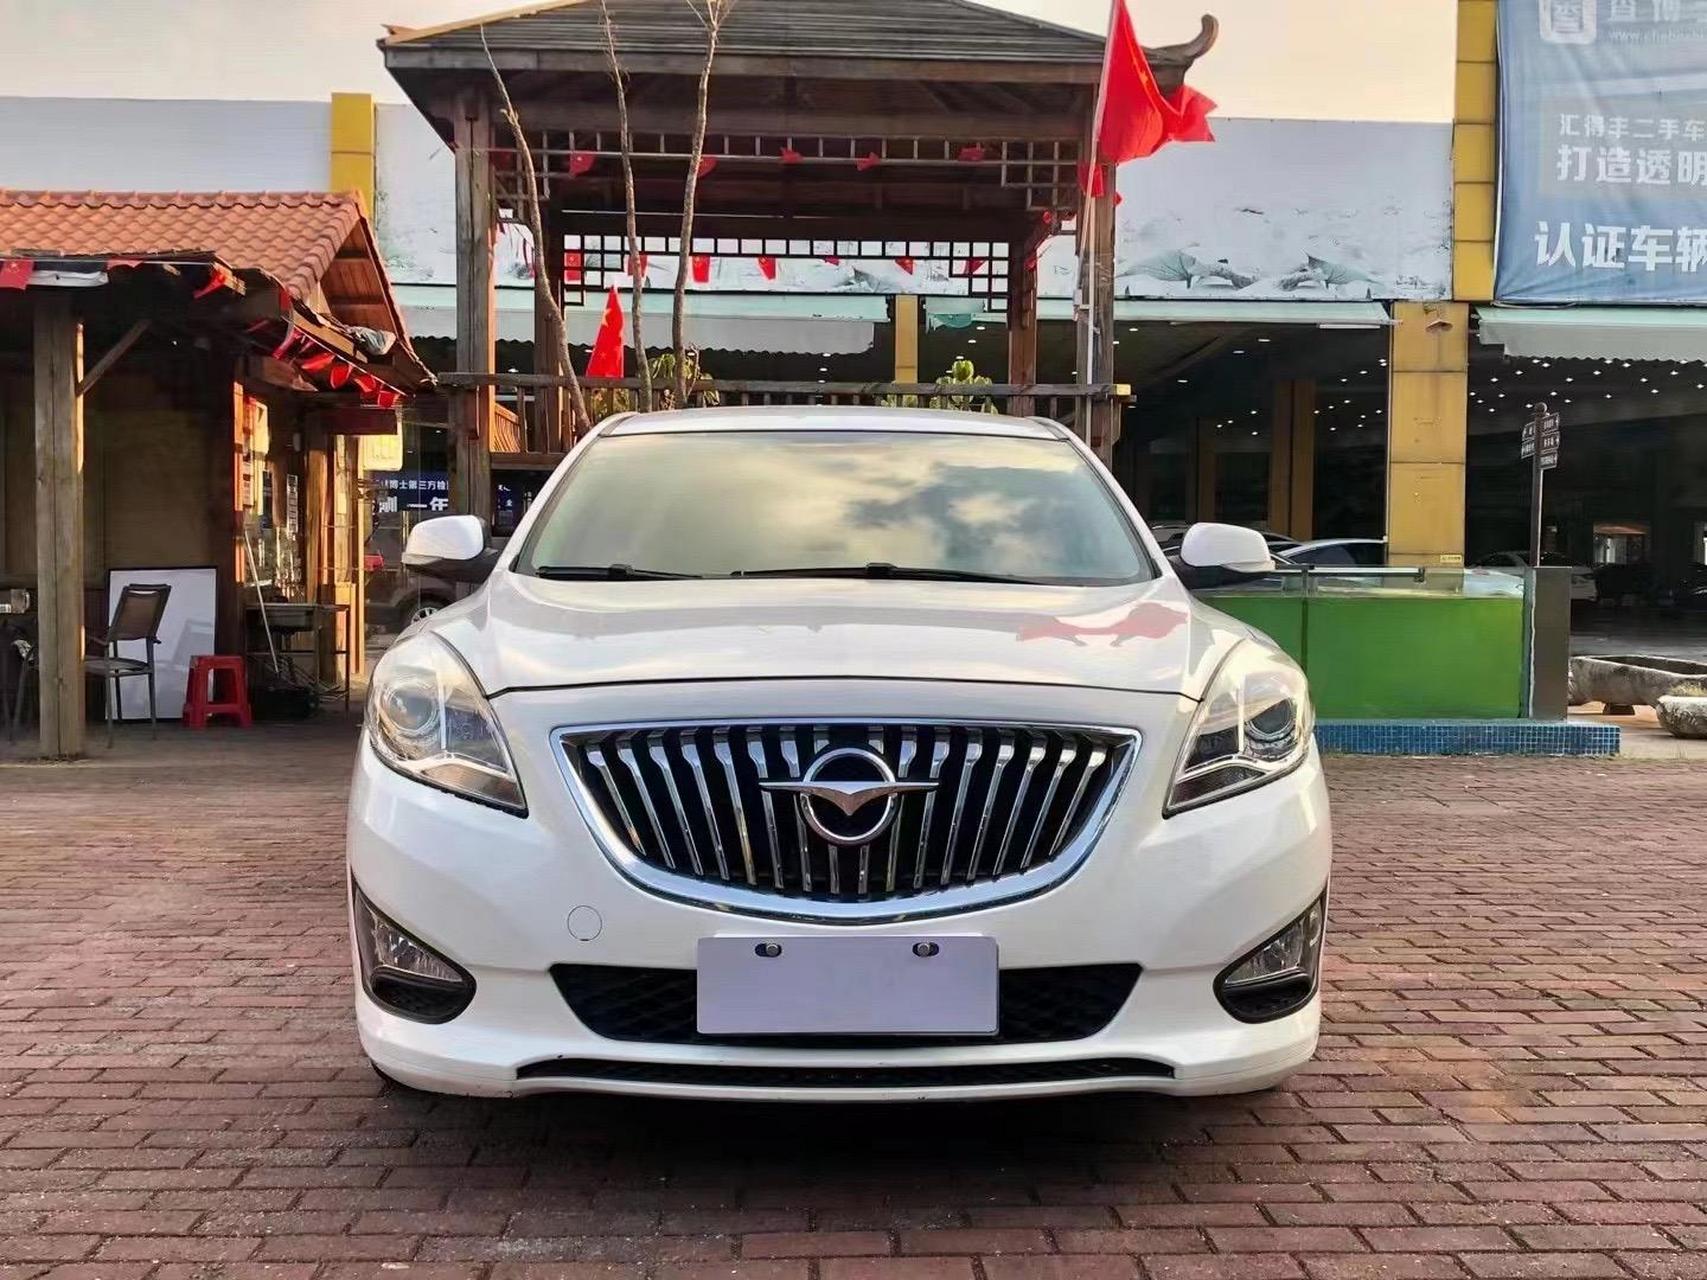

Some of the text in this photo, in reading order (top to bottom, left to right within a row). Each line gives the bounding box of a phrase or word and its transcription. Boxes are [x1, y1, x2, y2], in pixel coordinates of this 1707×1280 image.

[1557, 144, 1707, 186] 打造透明
[1534, 220, 1707, 273] 认证车辆
